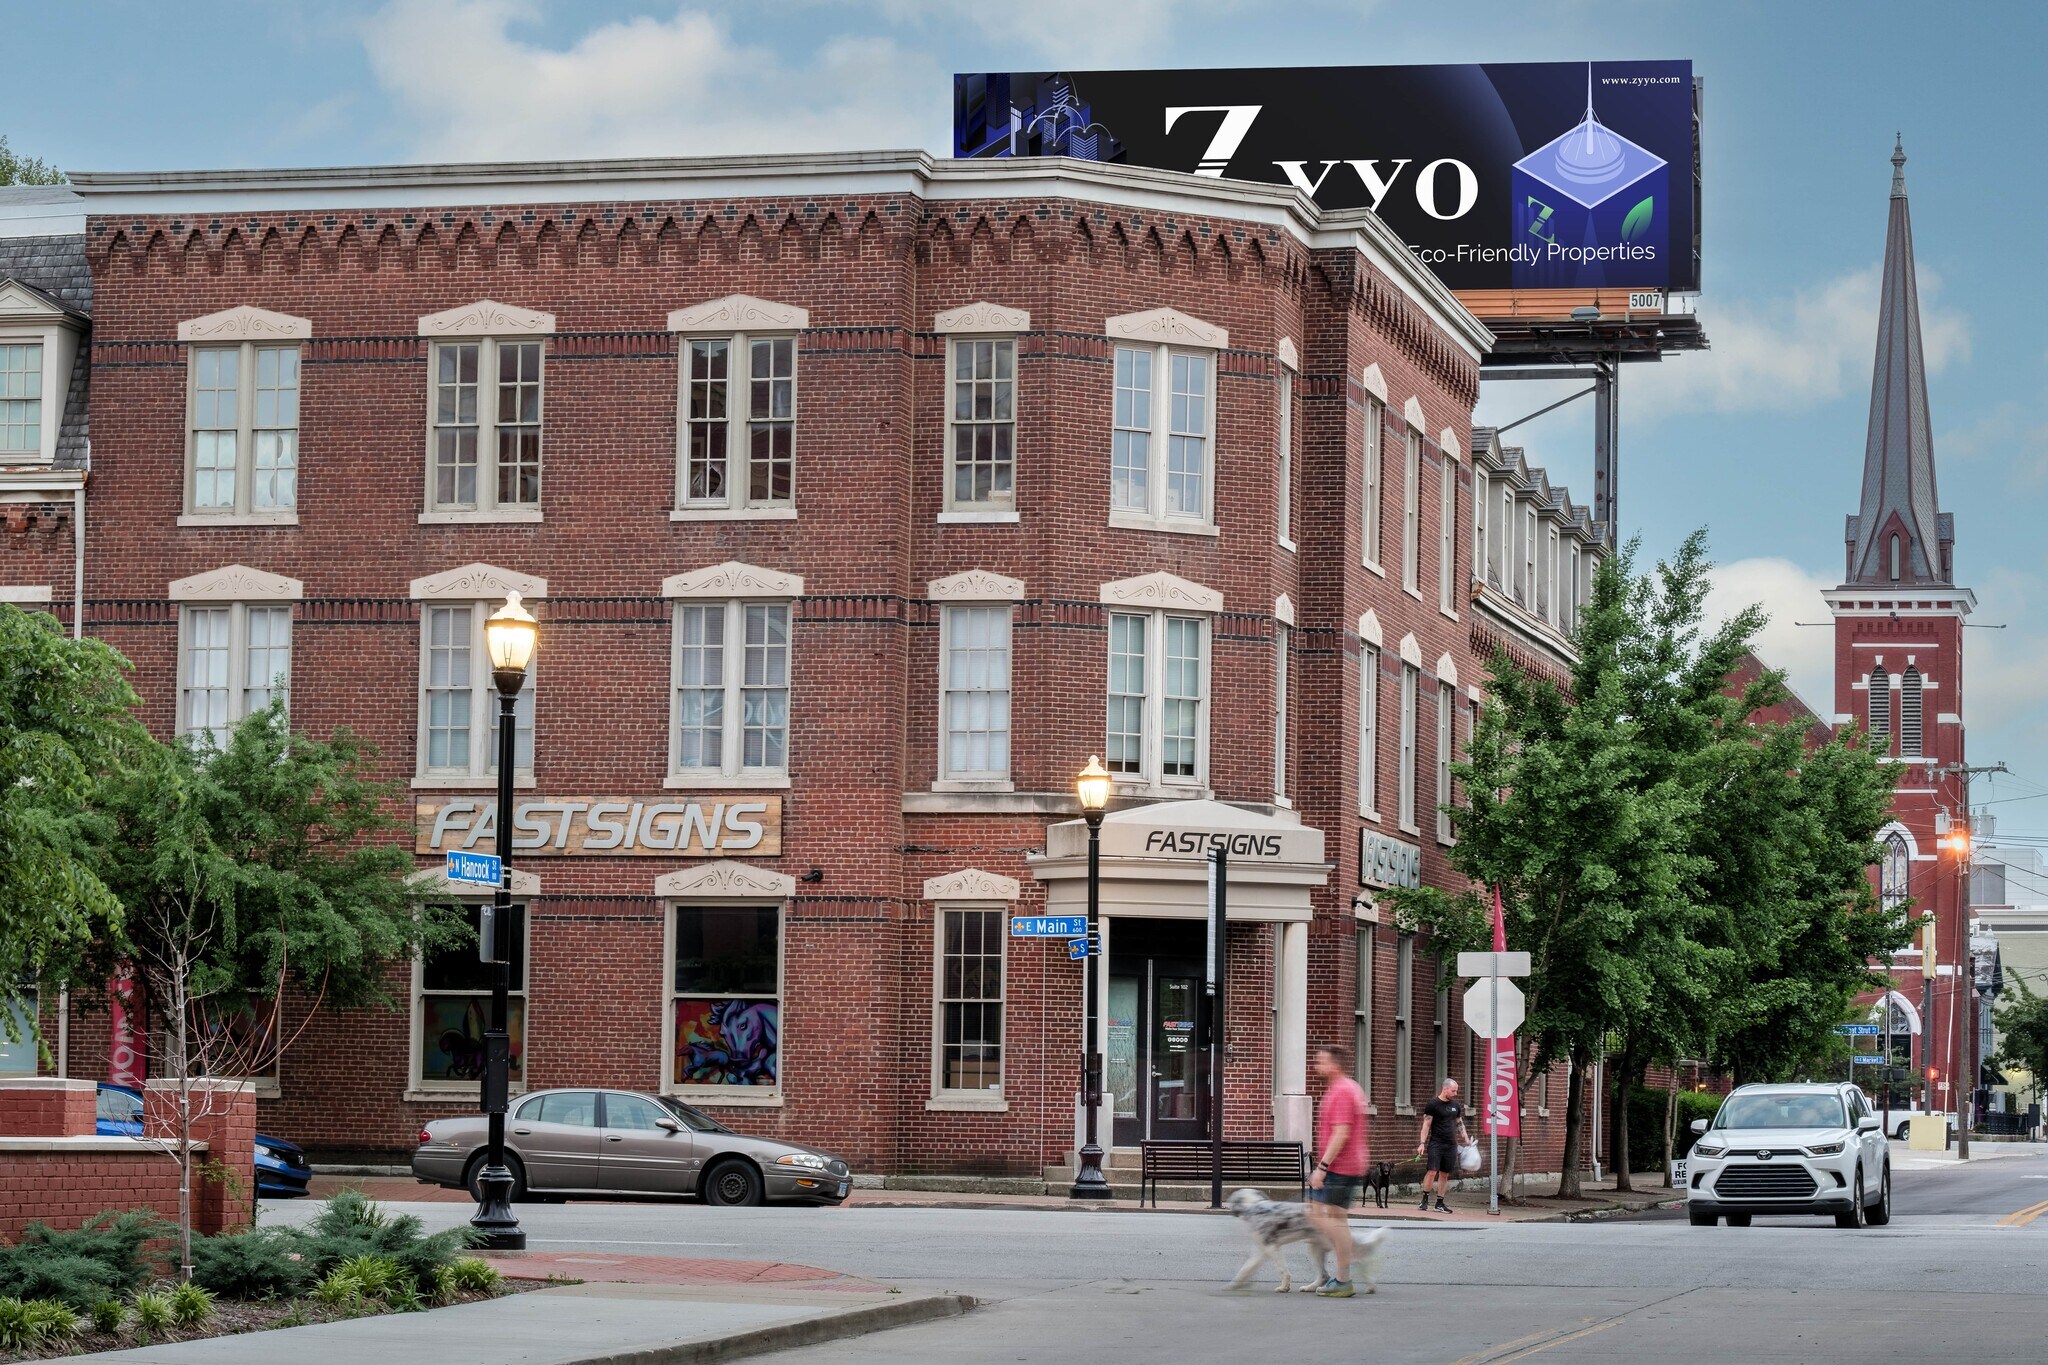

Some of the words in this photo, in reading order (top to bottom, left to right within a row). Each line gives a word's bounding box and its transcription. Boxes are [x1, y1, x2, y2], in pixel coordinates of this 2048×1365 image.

[1602, 77, 1680, 86] www.zyyo.com
[1547, 242, 1656, 265] Properties
[1631, 294, 1660, 307] 5007
[429, 803, 767, 850] FASTSIGNS
[1145, 831, 1282, 856] FASTSIGNS
[456, 859, 460, 872] N
[461, 856, 490, 879] Hancock
[492, 860, 496, 870] St
[1026, 922, 1032, 932] E
[1037, 919, 1067, 933] Main
[1073, 919, 1081, 927] St
[1080, 943, 1085, 953] S
